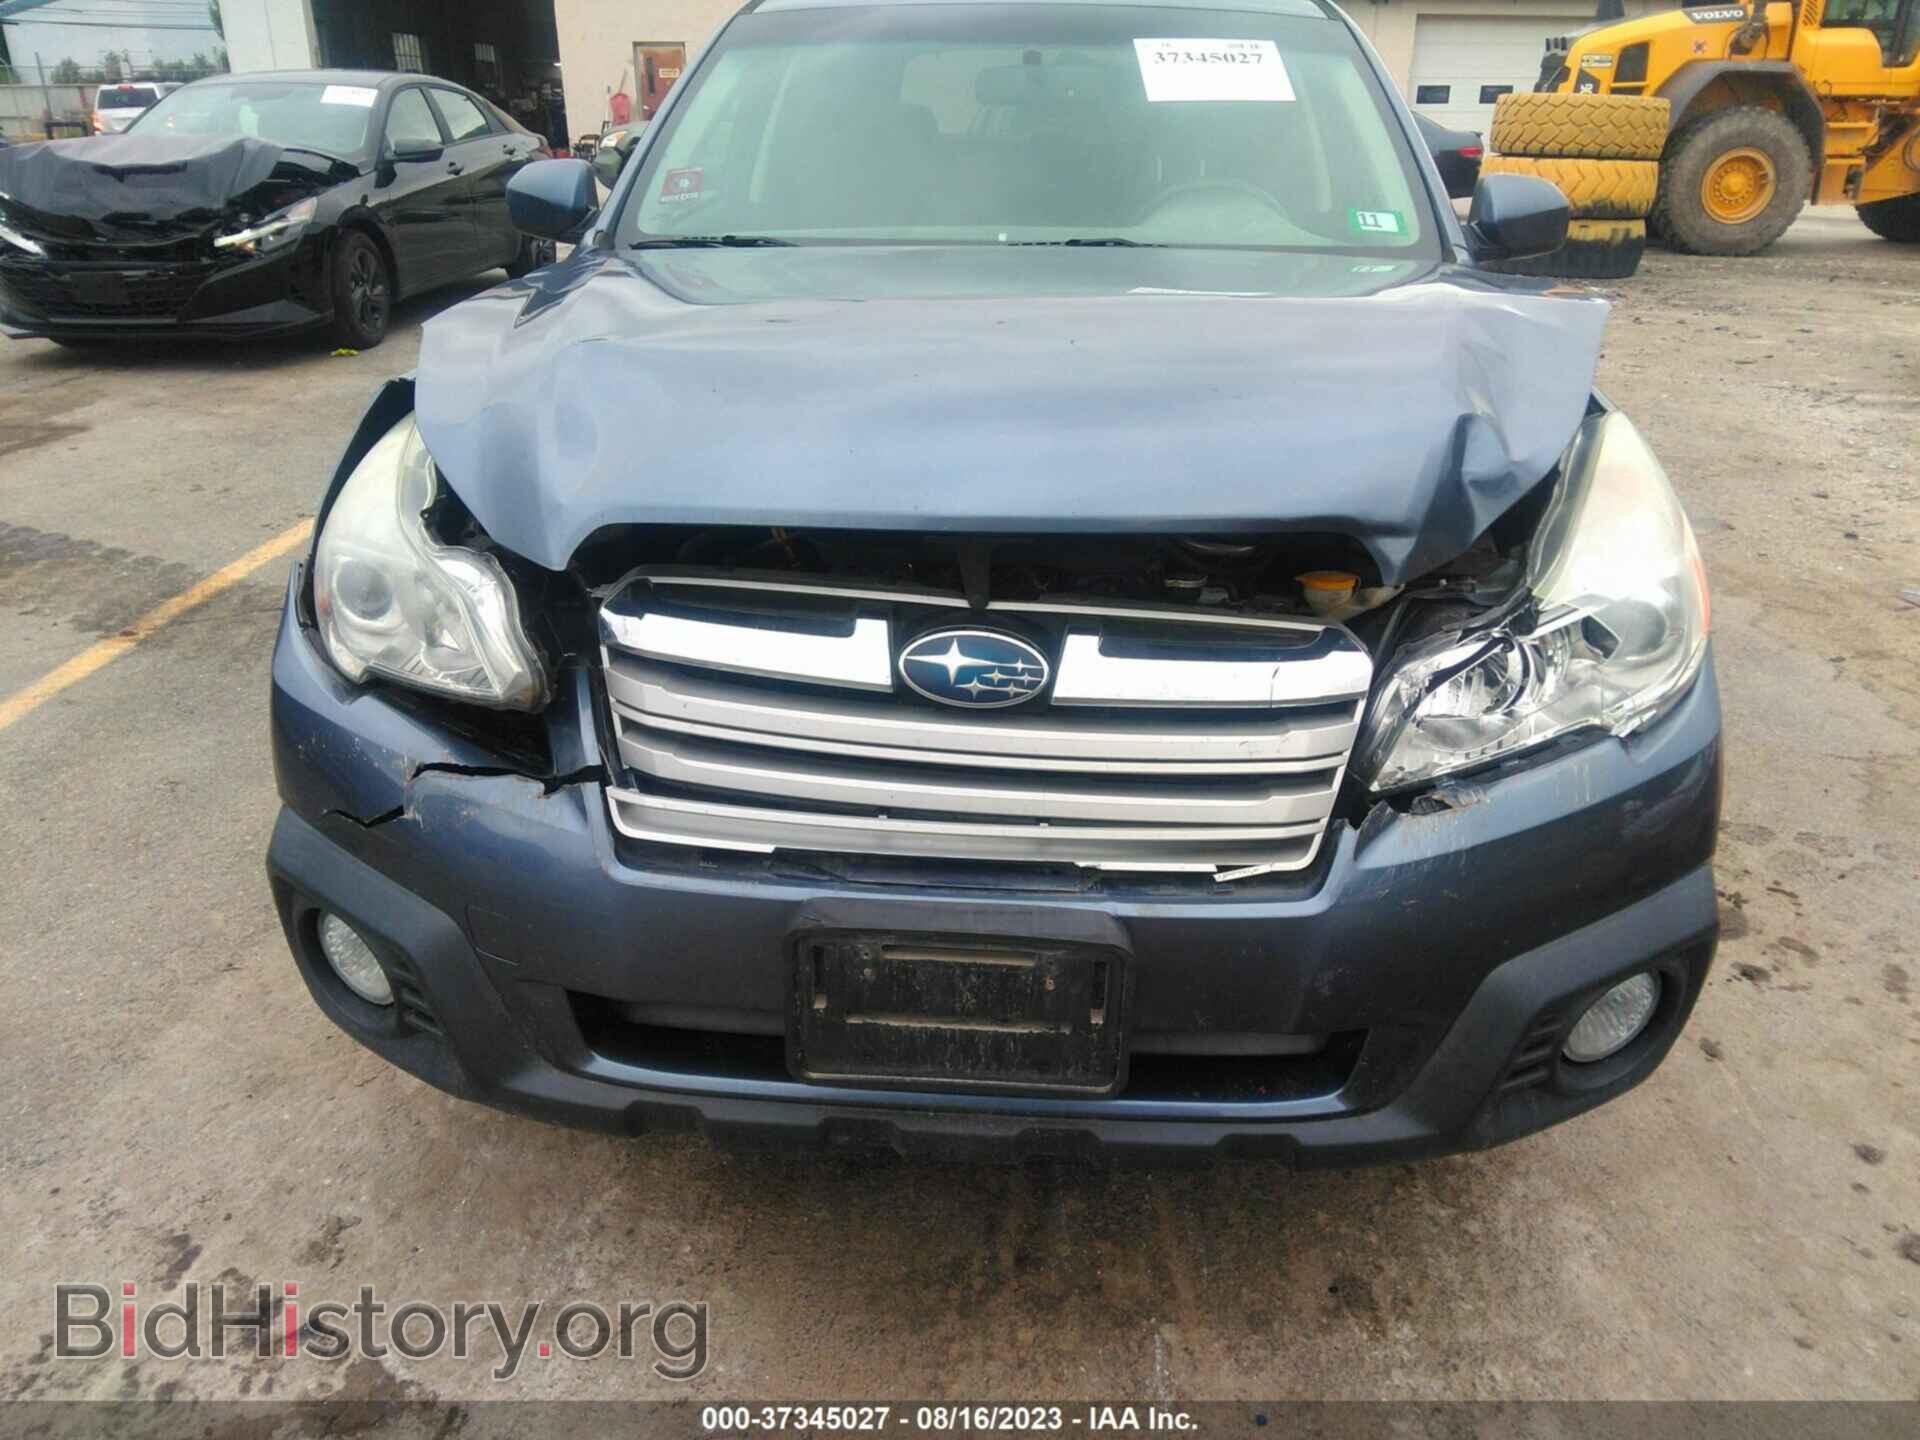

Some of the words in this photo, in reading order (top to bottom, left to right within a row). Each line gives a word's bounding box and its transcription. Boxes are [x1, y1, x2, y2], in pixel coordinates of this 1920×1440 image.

[1691, 9, 1744, 20] VOLVO
[1154, 51, 1263, 64] 37345027
[1359, 213, 1382, 228] 11
